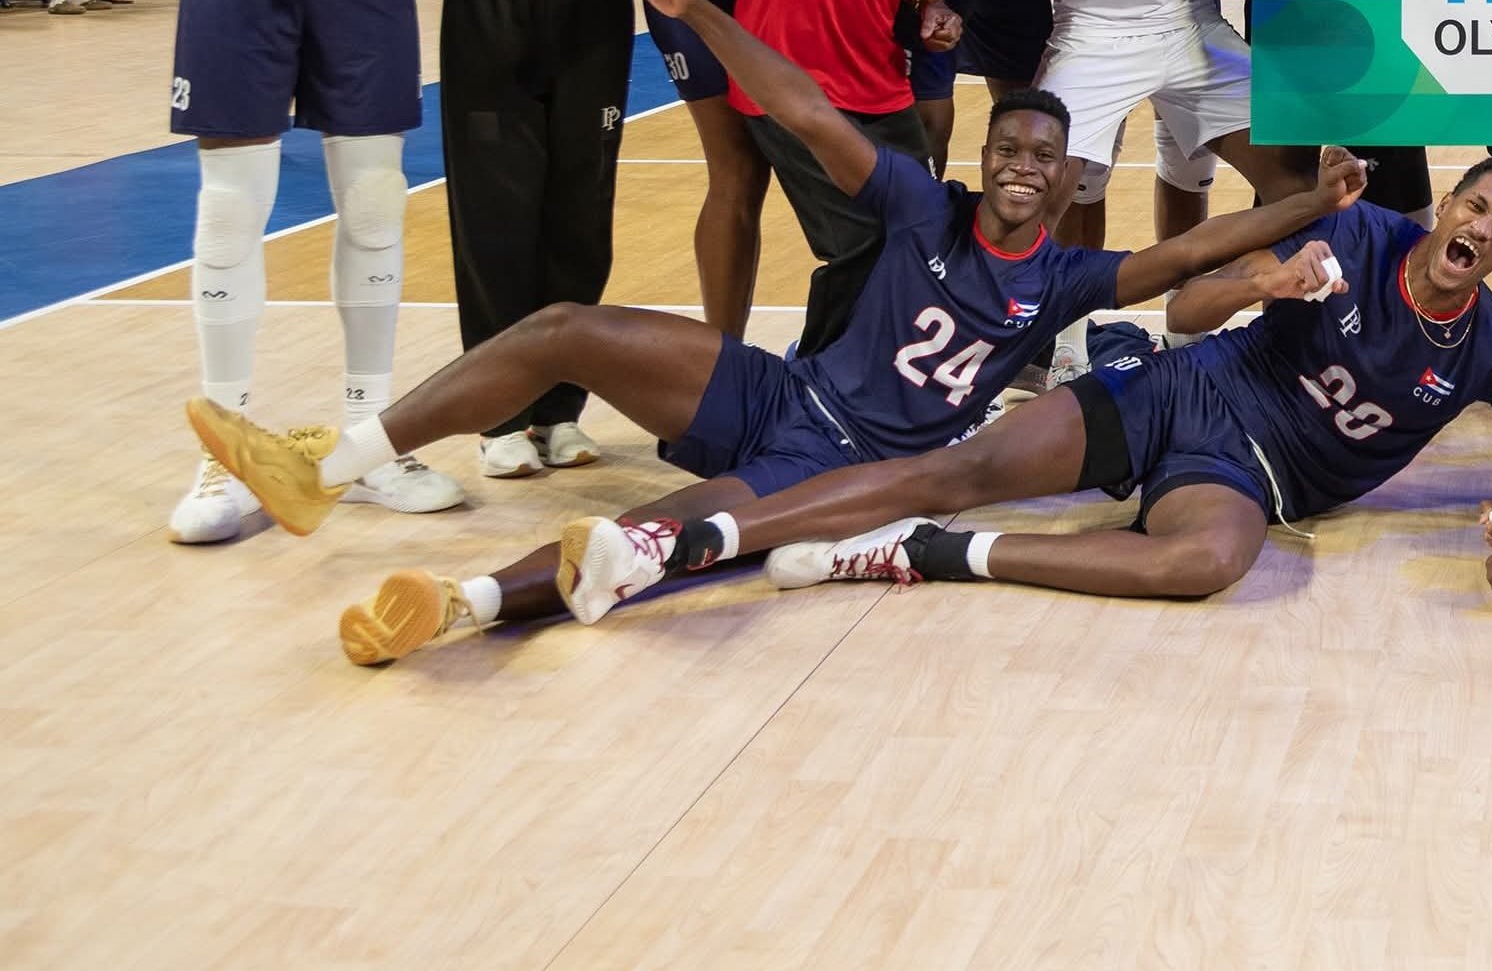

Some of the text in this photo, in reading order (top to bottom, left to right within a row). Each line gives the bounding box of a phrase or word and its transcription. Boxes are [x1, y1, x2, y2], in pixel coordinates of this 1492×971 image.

[666, 51, 689, 82] 30
[172, 75, 191, 113] 23
[893, 306, 996, 407] 24
[1412, 386, 1441, 407] CUB
